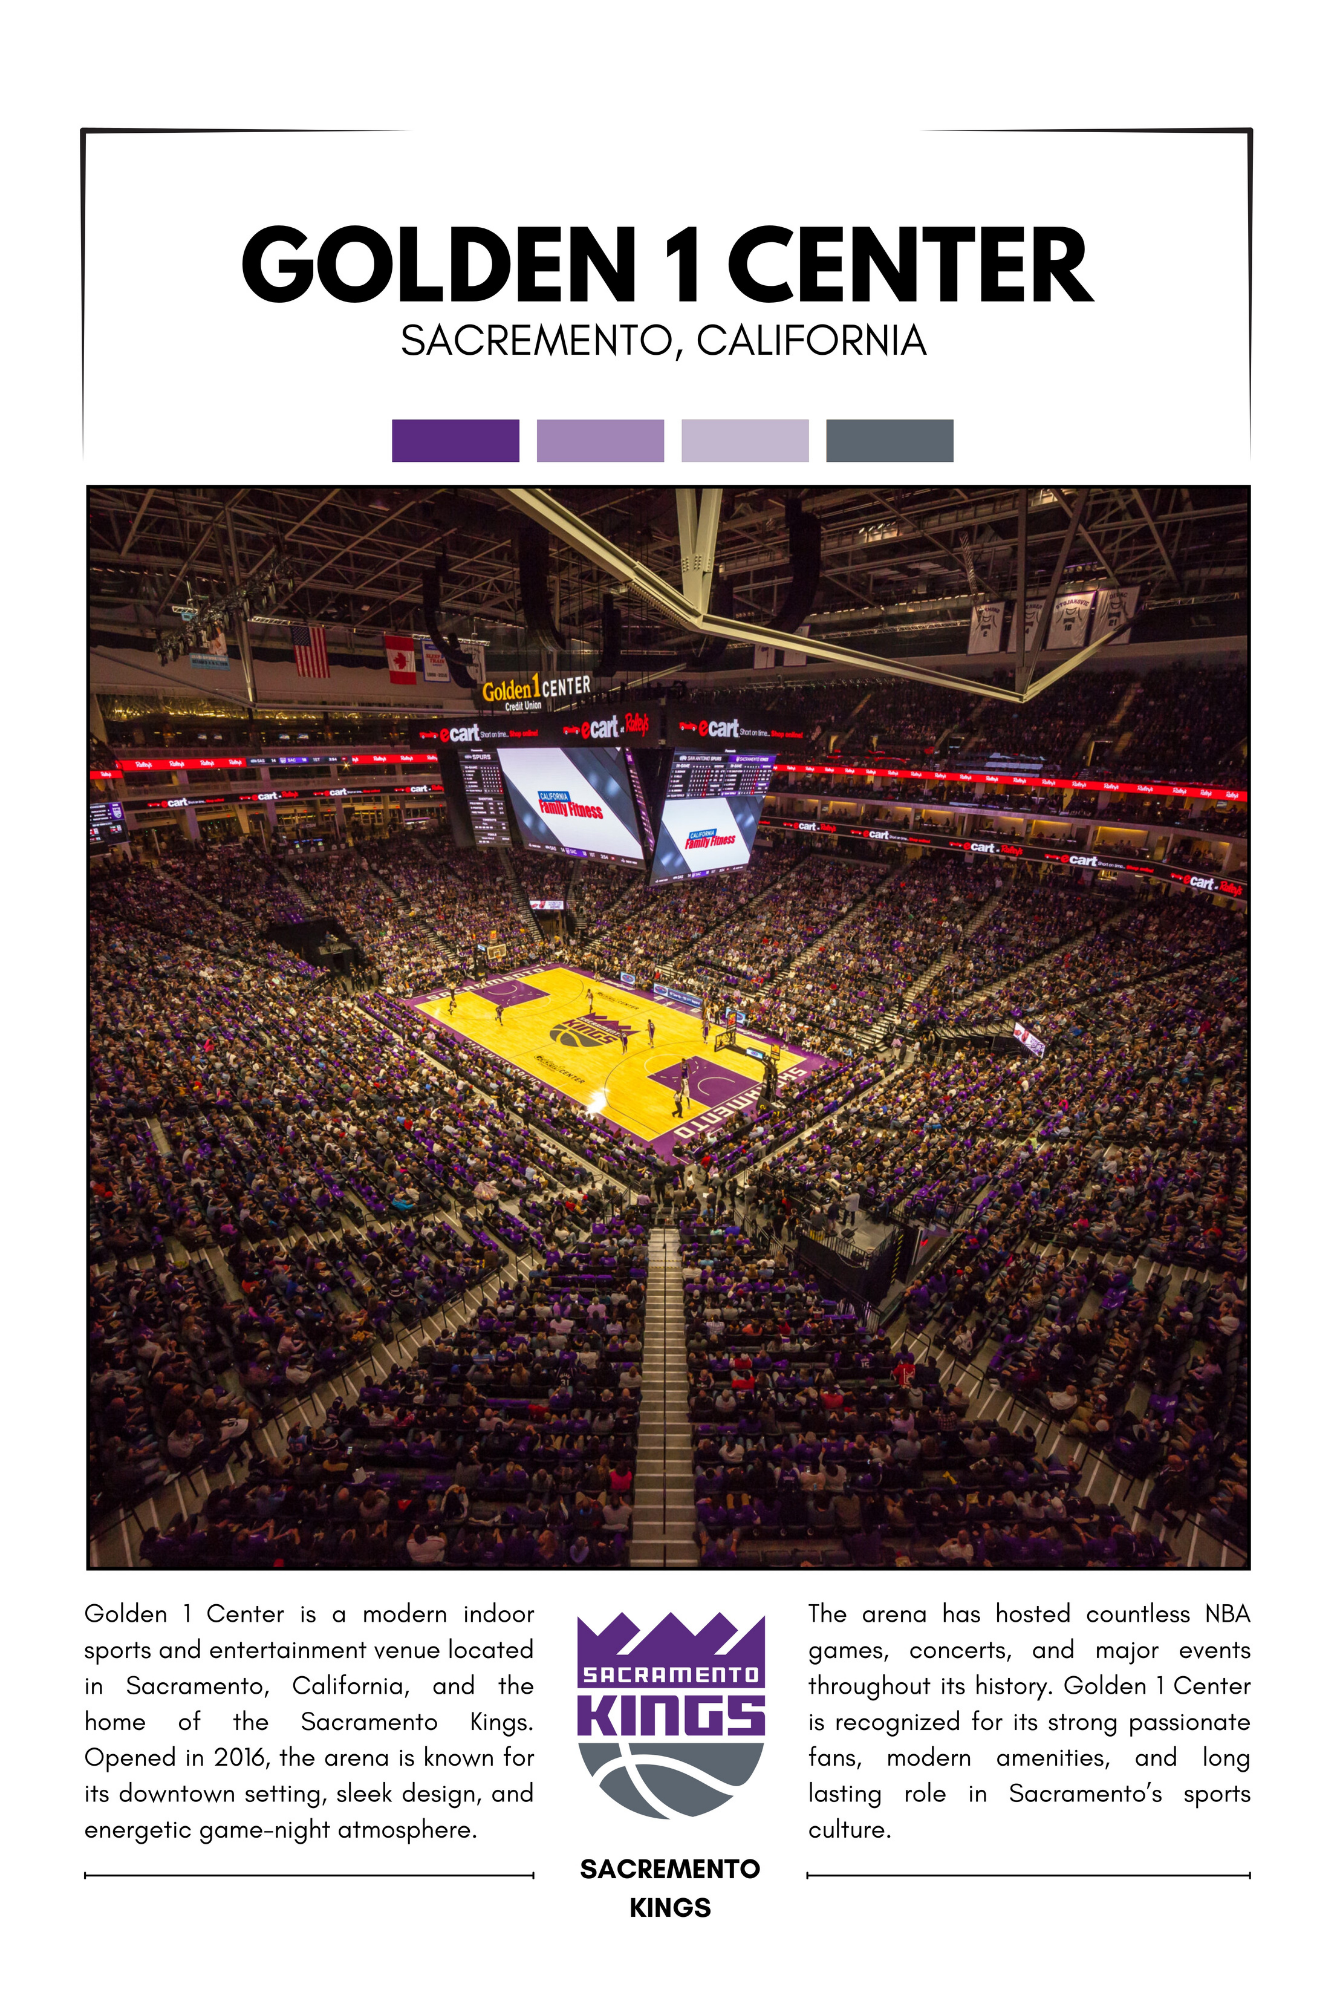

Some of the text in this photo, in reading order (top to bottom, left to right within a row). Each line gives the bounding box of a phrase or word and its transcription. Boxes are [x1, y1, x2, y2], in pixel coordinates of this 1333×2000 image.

[542, 675, 591, 698] CENTER
[506, 703, 523, 711] Credit
[440, 724, 480, 742] ecart
[581, 715, 619, 739] ecart
[699, 719, 739, 738] ecart
[539, 799, 603, 819] Family Fitness
[685, 835, 736, 849] Family Fitness
[691, 830, 715, 839] CALIFORNIA
[1061, 855, 1098, 867] ecart
[1183, 875, 1214, 890] ecart
[562, 1019, 618, 1044] KINGS
